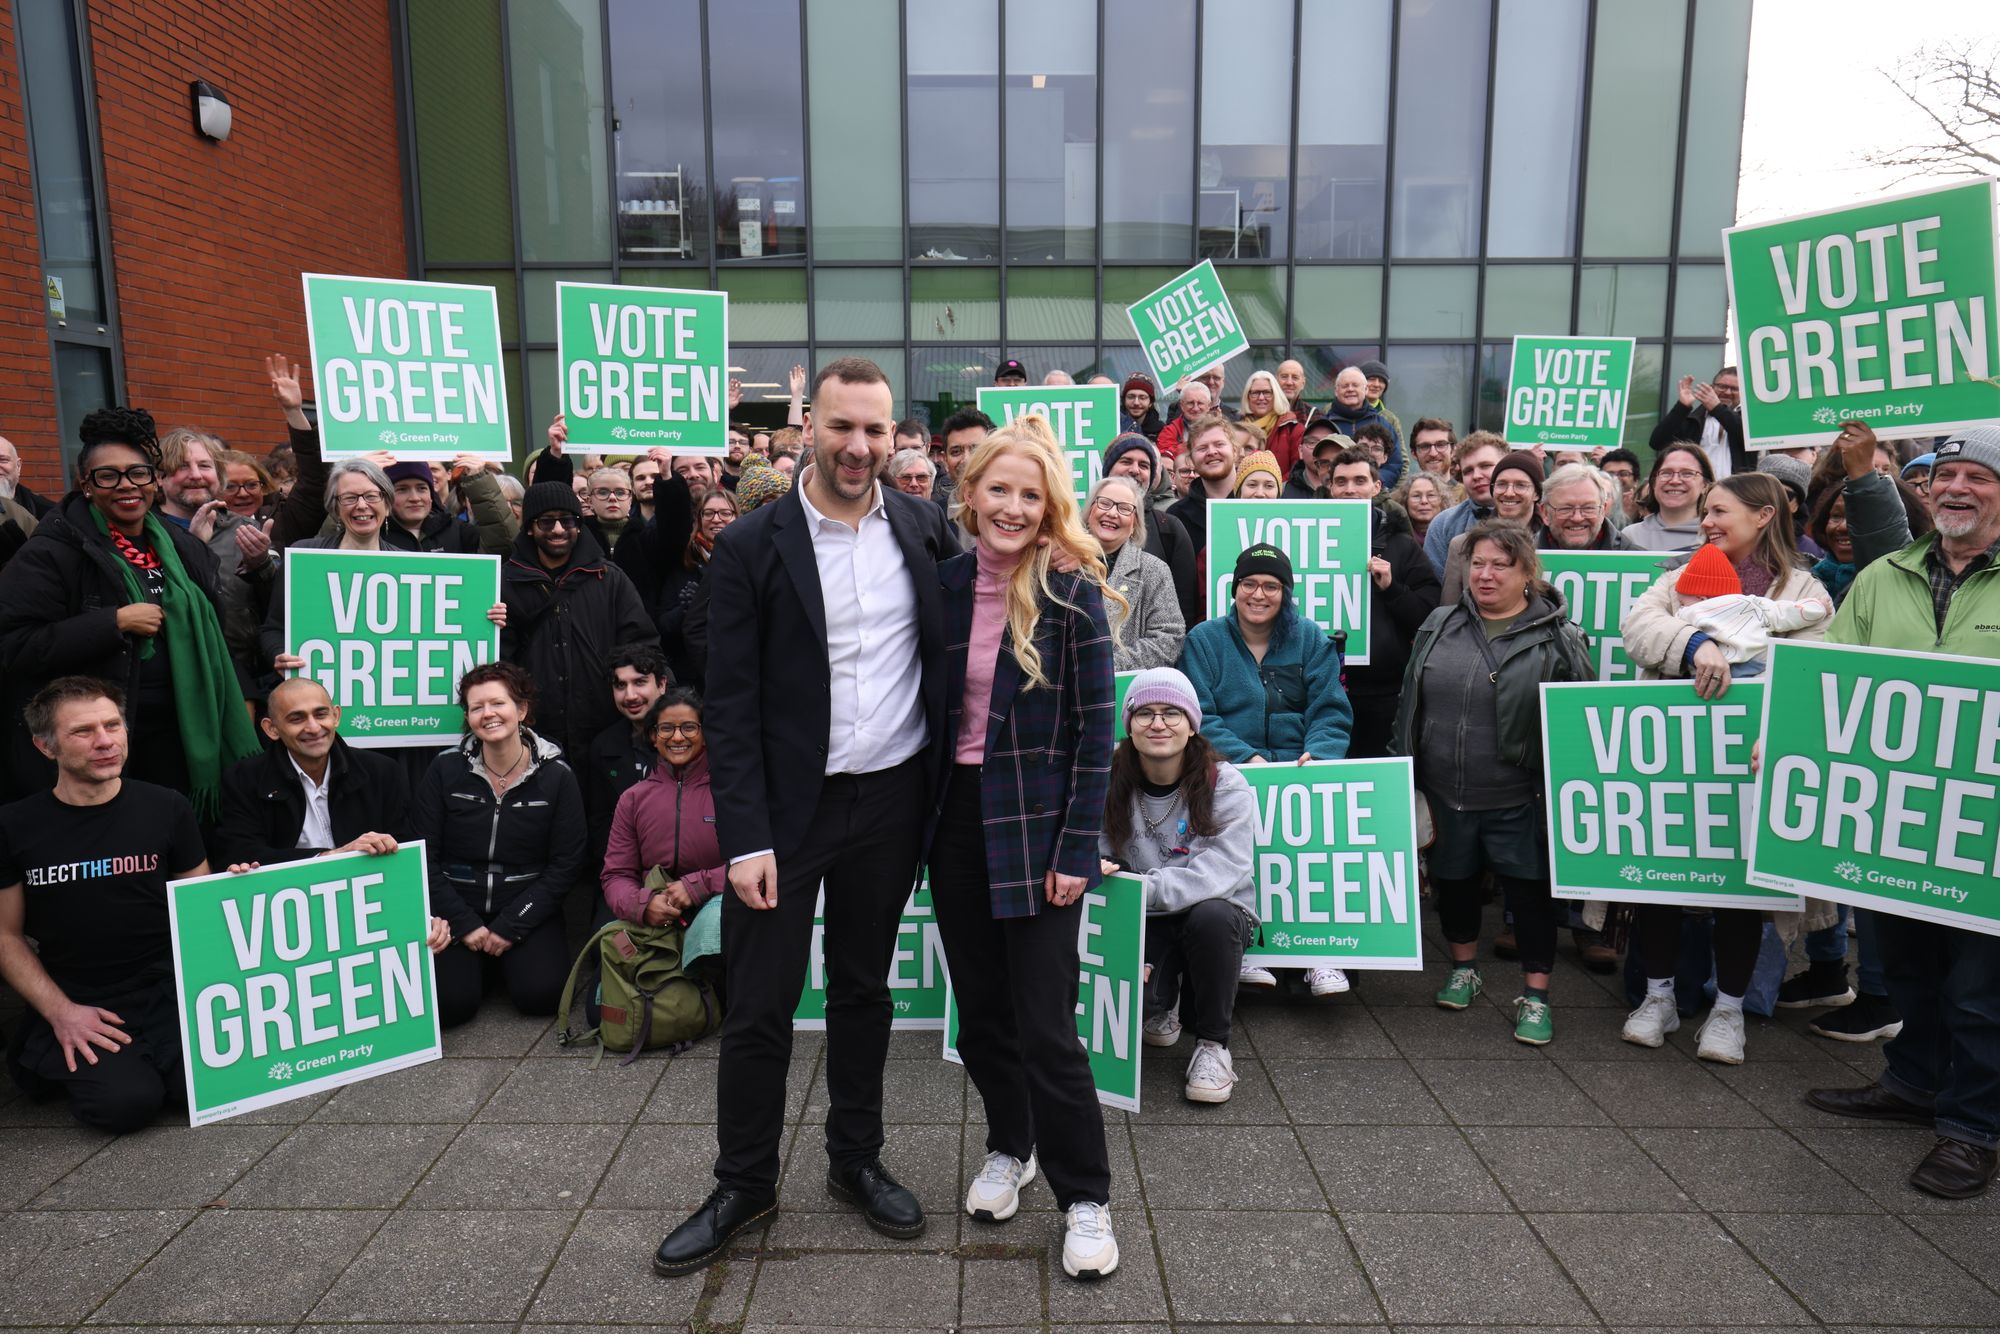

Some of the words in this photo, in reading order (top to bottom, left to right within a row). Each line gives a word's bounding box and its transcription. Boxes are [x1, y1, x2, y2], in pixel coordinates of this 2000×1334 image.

[1769, 216, 1945, 316] VOTE
[342, 296, 469, 358] VOTE
[589, 303, 698, 360] VOTE
[1145, 278, 1210, 334] VOTE
[1149, 301, 1236, 372] GREEN
[1206, 348, 1220, 359] Party
[1748, 296, 1989, 404] GREEN
[324, 357, 499, 425] GREEN
[568, 359, 719, 422] GREEN
[1534, 348, 1612, 386] VOTE
[629, 429, 656, 438] Green
[658, 430, 682, 440] Party
[1512, 386, 1622, 429] GREEN
[1839, 407, 1882, 420] Green
[1885, 402, 1924, 417] Party
[400, 433, 430, 443] Green
[433, 433, 460, 445] Party
[1571, 433, 1588, 441] Party
[327, 572, 463, 634] VOTE
[1542, 571, 1650, 631] OTE
[374, 717, 408, 727] Green
[411, 717, 441, 728] Party
[1584, 704, 1749, 775] VOTE
[1821, 672, 2000, 776] VOTE
[1251, 782, 1377, 847] VOTE
[1768, 755, 2000, 879] GREE
[1252, 851, 1408, 924] REEN
[1646, 869, 1686, 882] Green
[1690, 871, 1726, 886] Party
[1866, 870, 1917, 891] Green
[1922, 880, 1968, 902] Party
[221, 872, 388, 971] VOTE
[1293, 935, 1326, 946] Green
[1329, 935, 1359, 949] Party
[195, 941, 425, 1069] GREEN
[895, 1000, 911, 1012] rty
[295, 1052, 336, 1072] Green
[339, 1044, 374, 1062] Party
